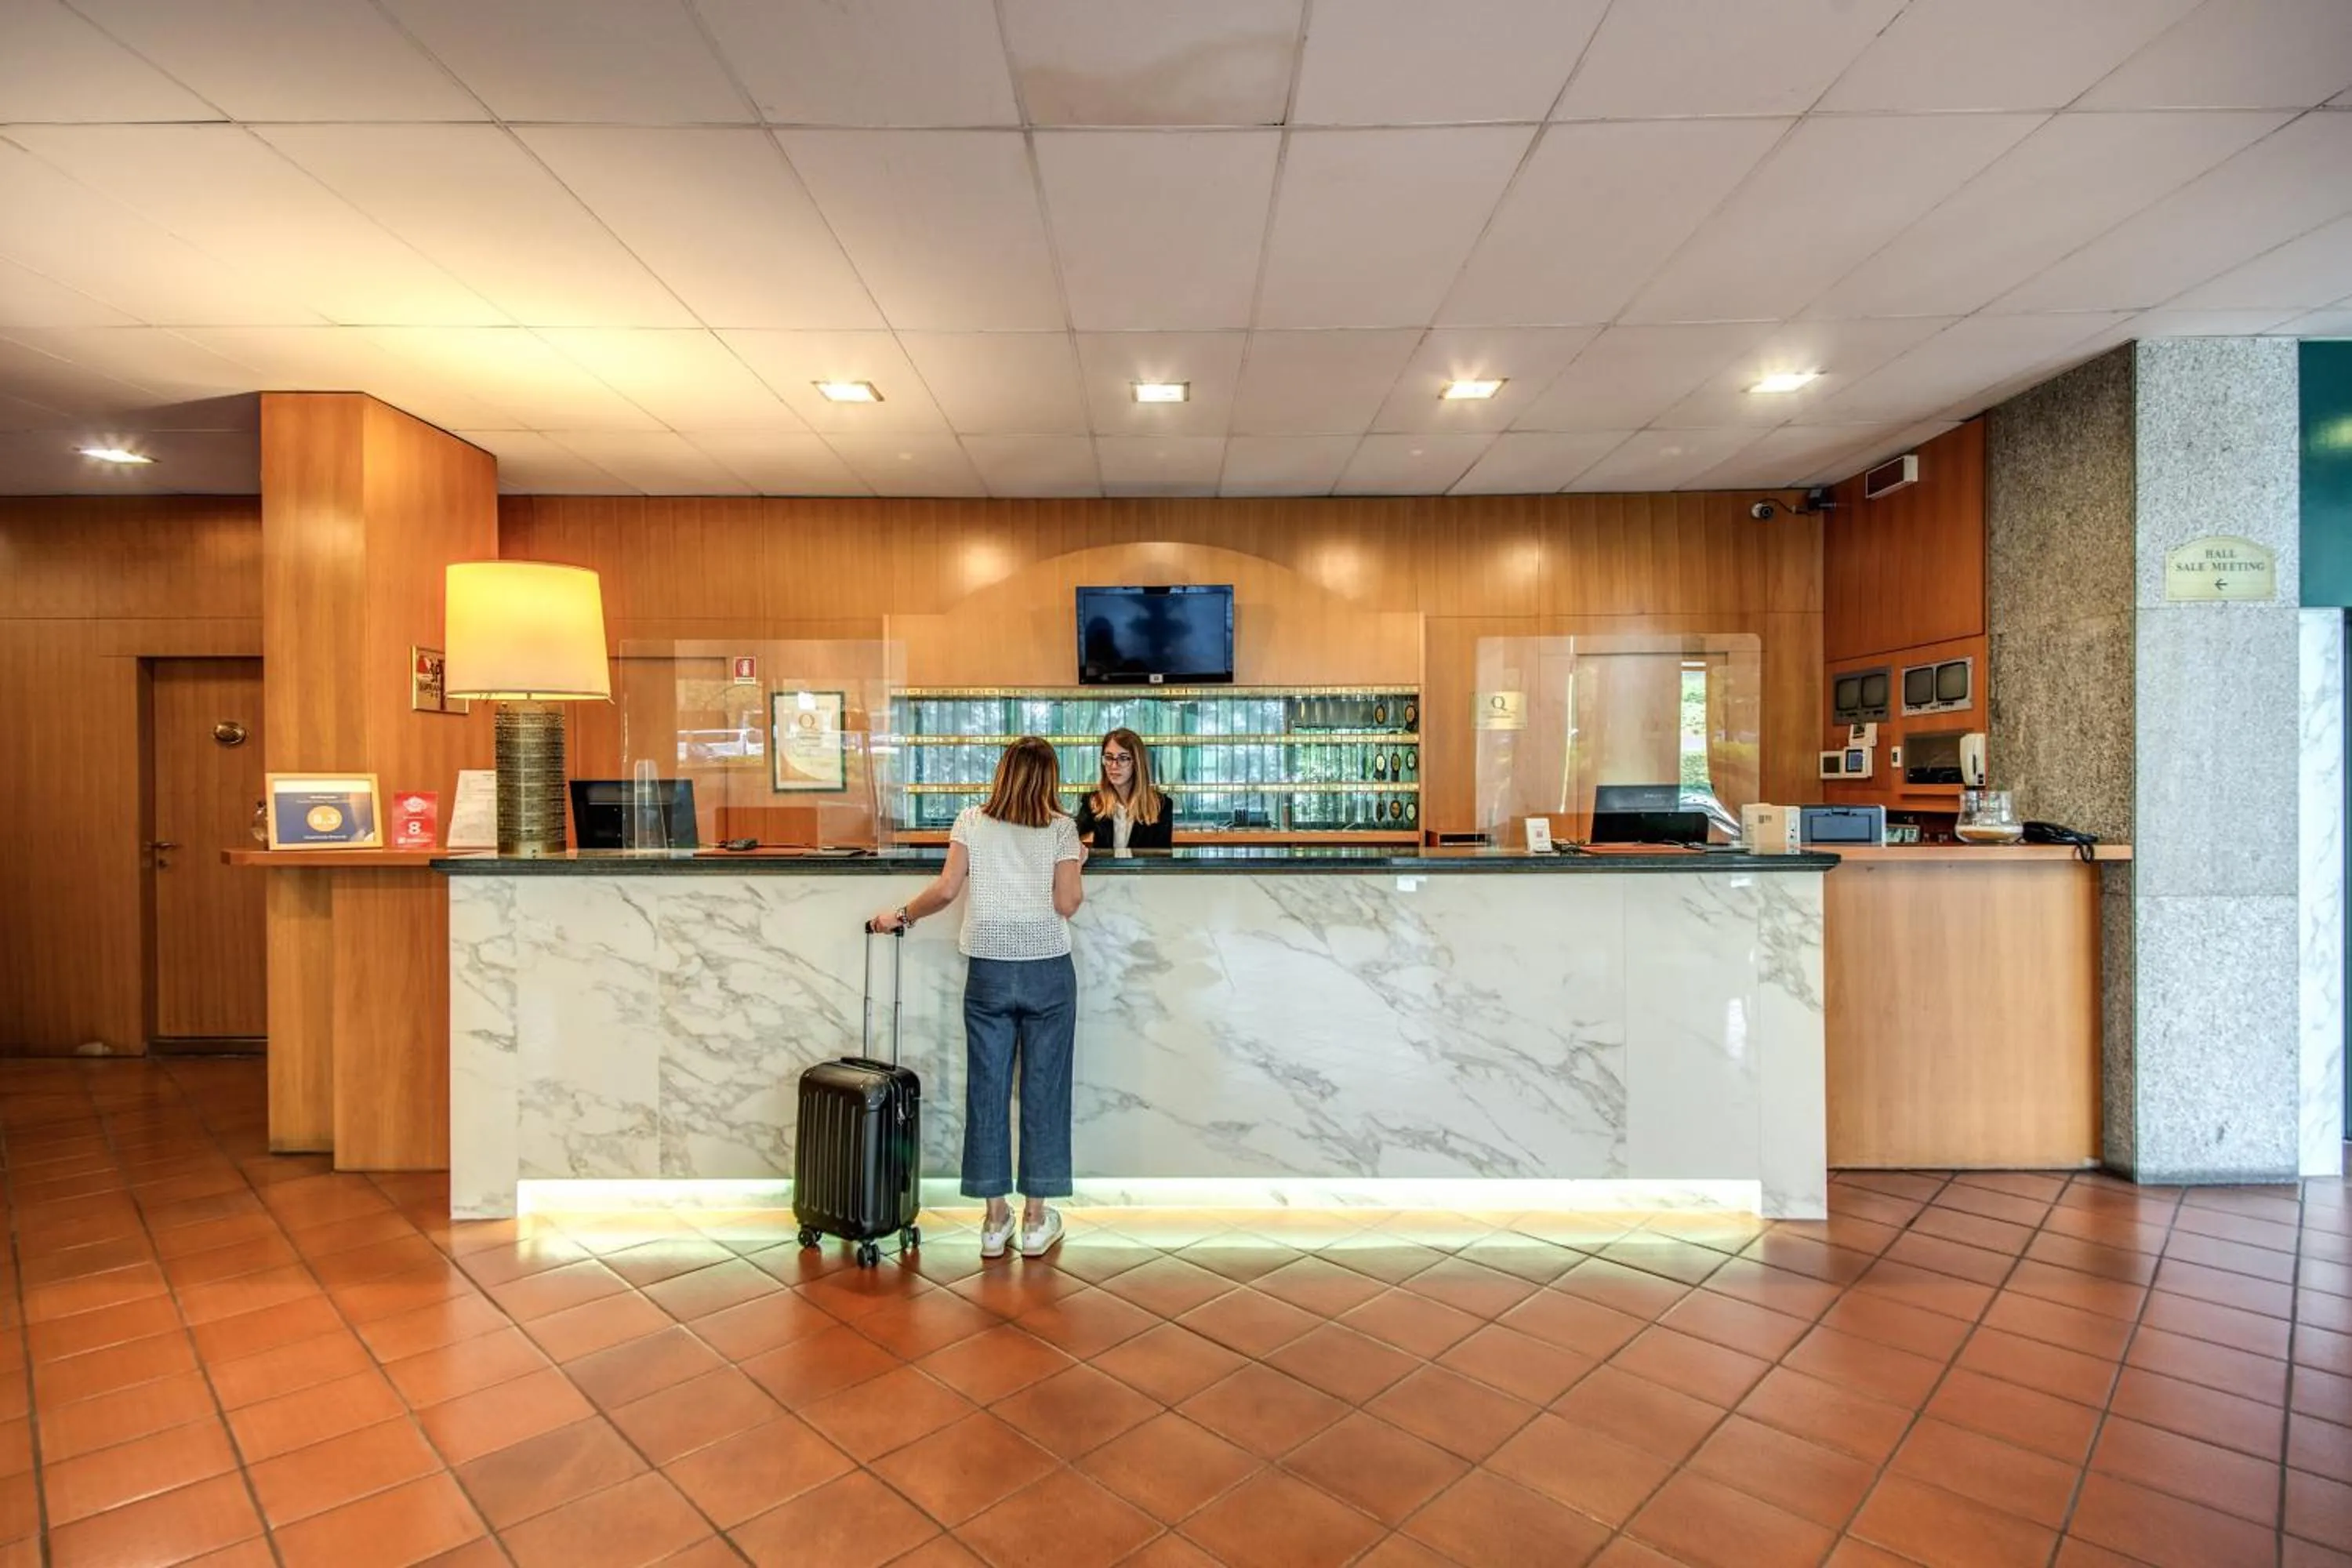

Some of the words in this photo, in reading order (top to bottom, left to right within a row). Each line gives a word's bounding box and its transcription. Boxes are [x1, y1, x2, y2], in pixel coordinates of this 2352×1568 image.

[2205, 549, 2237, 559] HALL
[2176, 562, 2205, 572] SALE
[2212, 562, 2265, 572] MEETING
